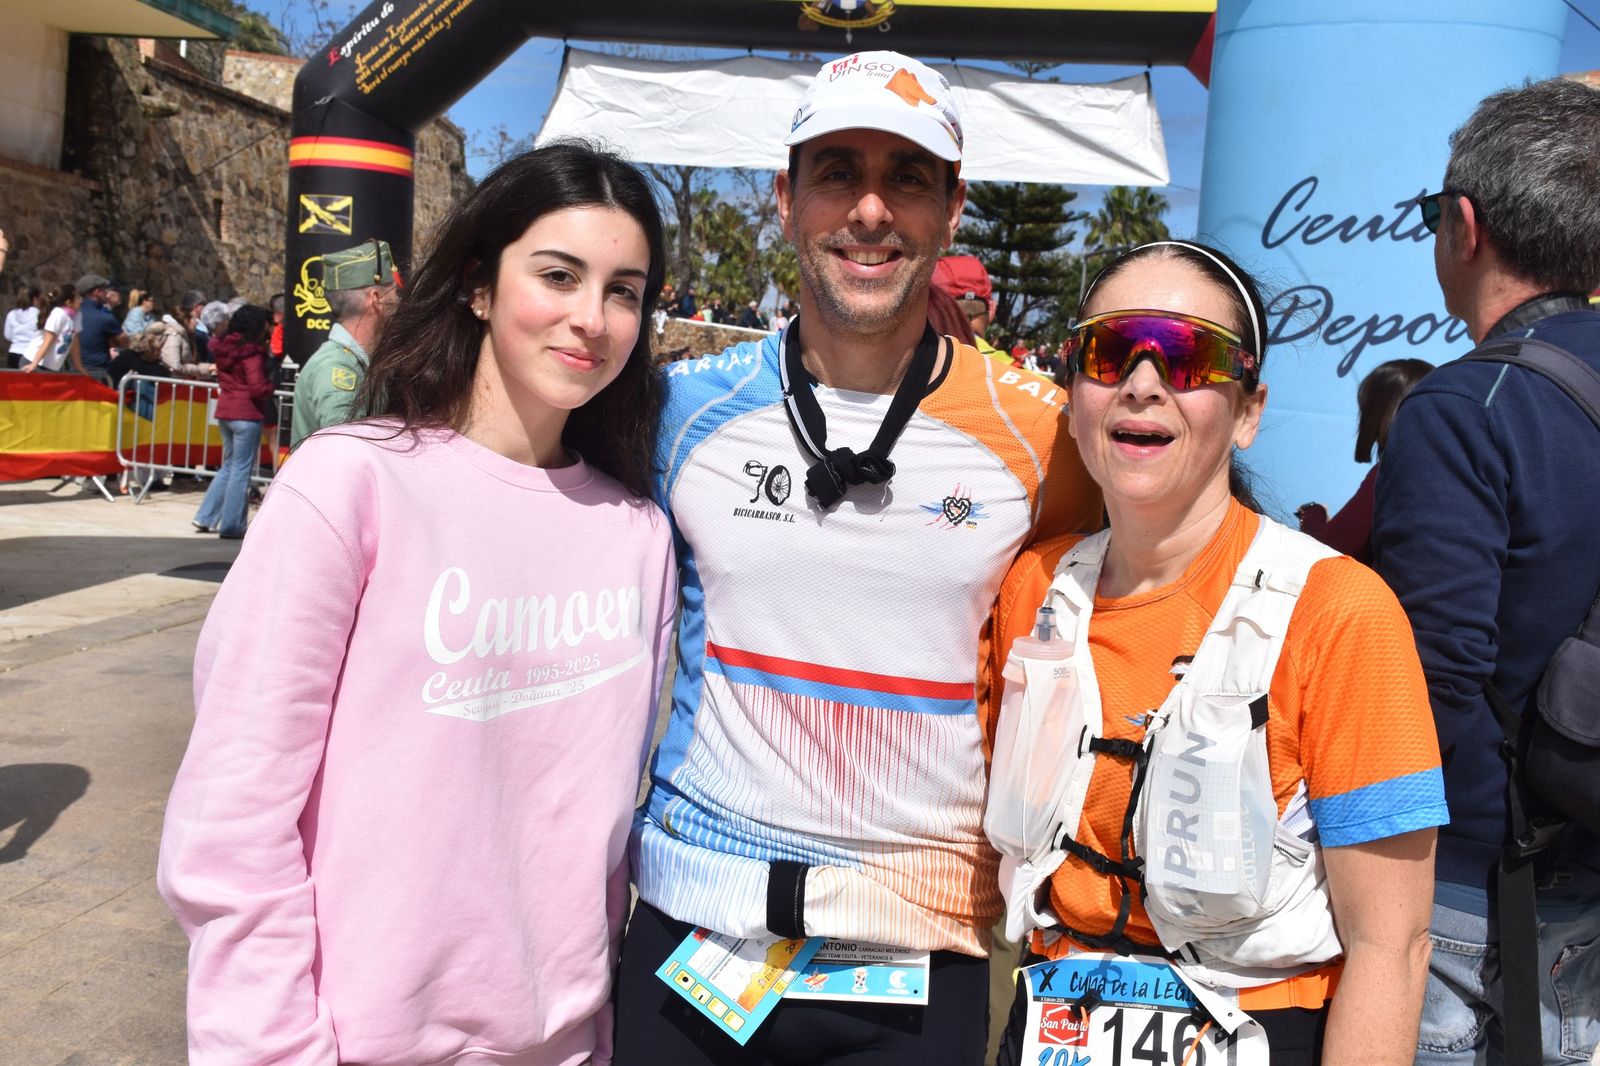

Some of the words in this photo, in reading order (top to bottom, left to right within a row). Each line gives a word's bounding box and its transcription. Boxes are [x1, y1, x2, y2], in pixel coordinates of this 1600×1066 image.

[380, 1, 394, 19] de
[1261, 175, 1437, 249] Cent
[306, 318, 331, 331] DCC
[1265, 284, 1474, 379] Depor
[997, 370, 1057, 408] BAL
[423, 566, 642, 665] Camoen
[421, 667, 511, 704] Ceuta
[526, 652, 601, 686] 1995-2025
[820, 941, 858, 952] NTONIO
[1038, 965, 1060, 994] X
[1040, 1016, 1059, 1030] San
[1060, 1018, 1089, 1032] Pablo
